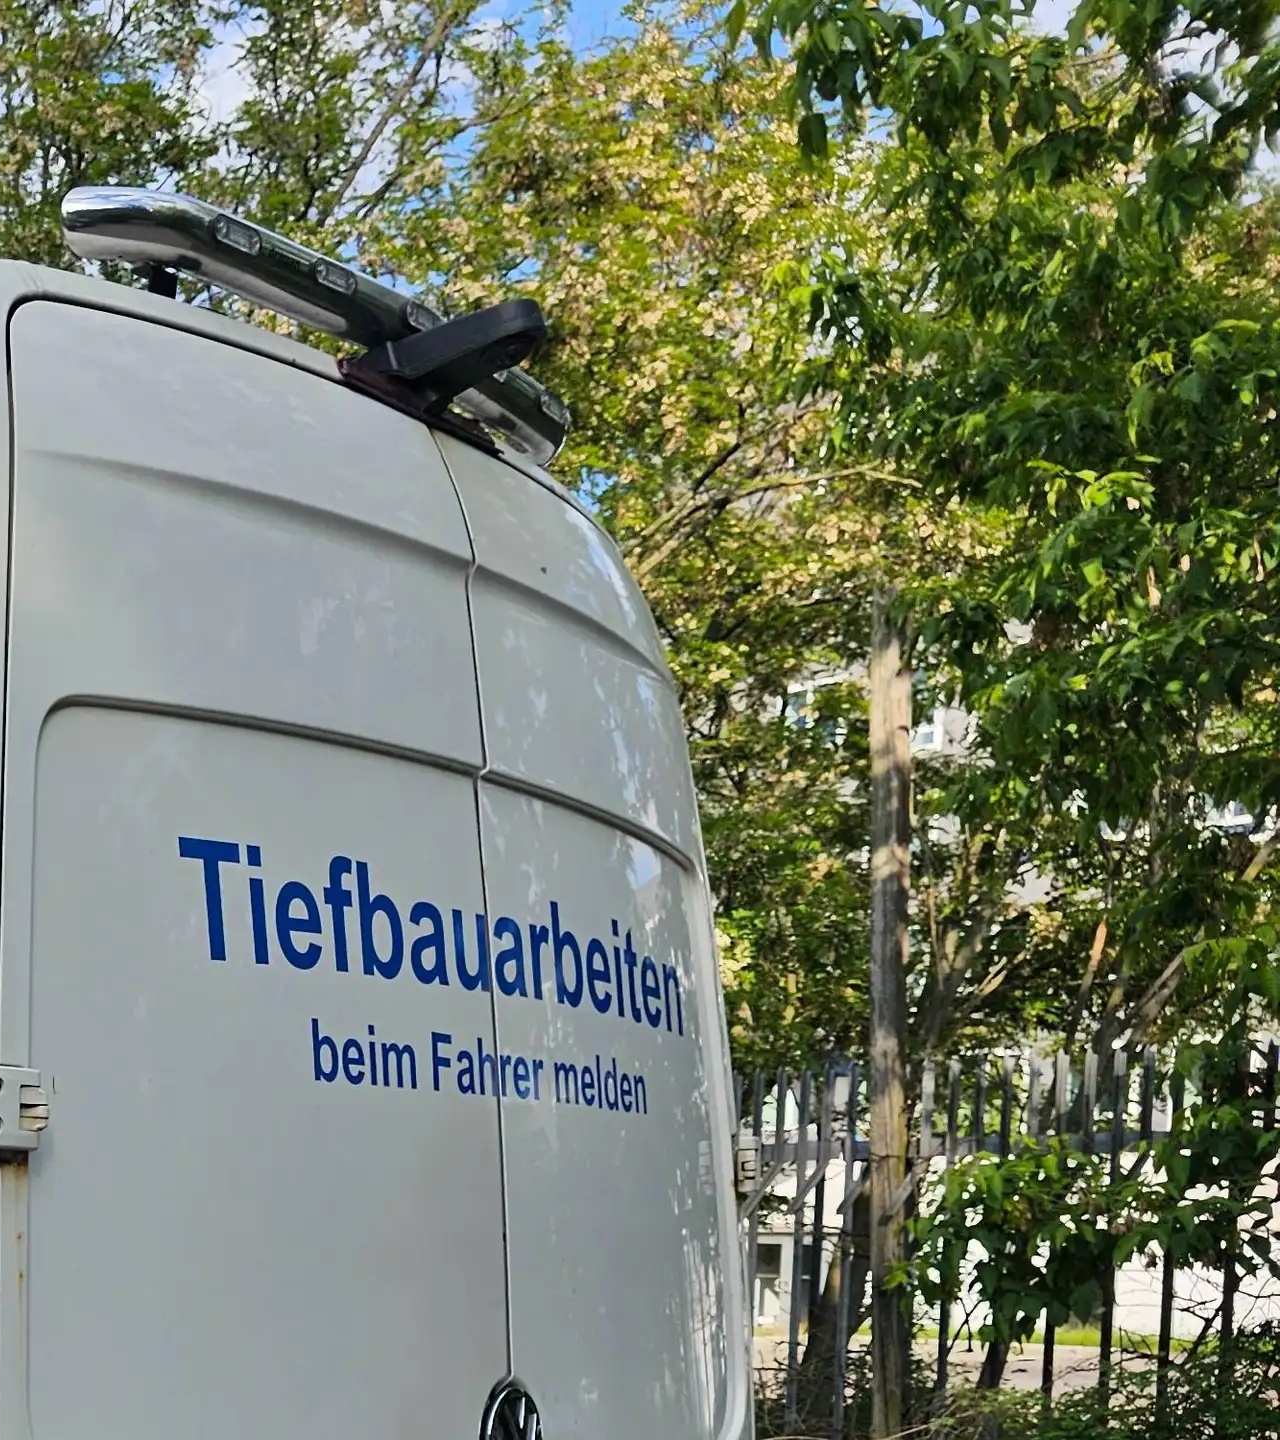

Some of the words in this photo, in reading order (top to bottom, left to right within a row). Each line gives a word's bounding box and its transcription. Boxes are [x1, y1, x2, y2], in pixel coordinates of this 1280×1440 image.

[178, 836, 684, 1037] Tiefbauarbeiten
[311, 1017, 418, 1090] beim
[430, 1031, 543, 1102] Fahrer
[553, 1055, 648, 1115] melden
